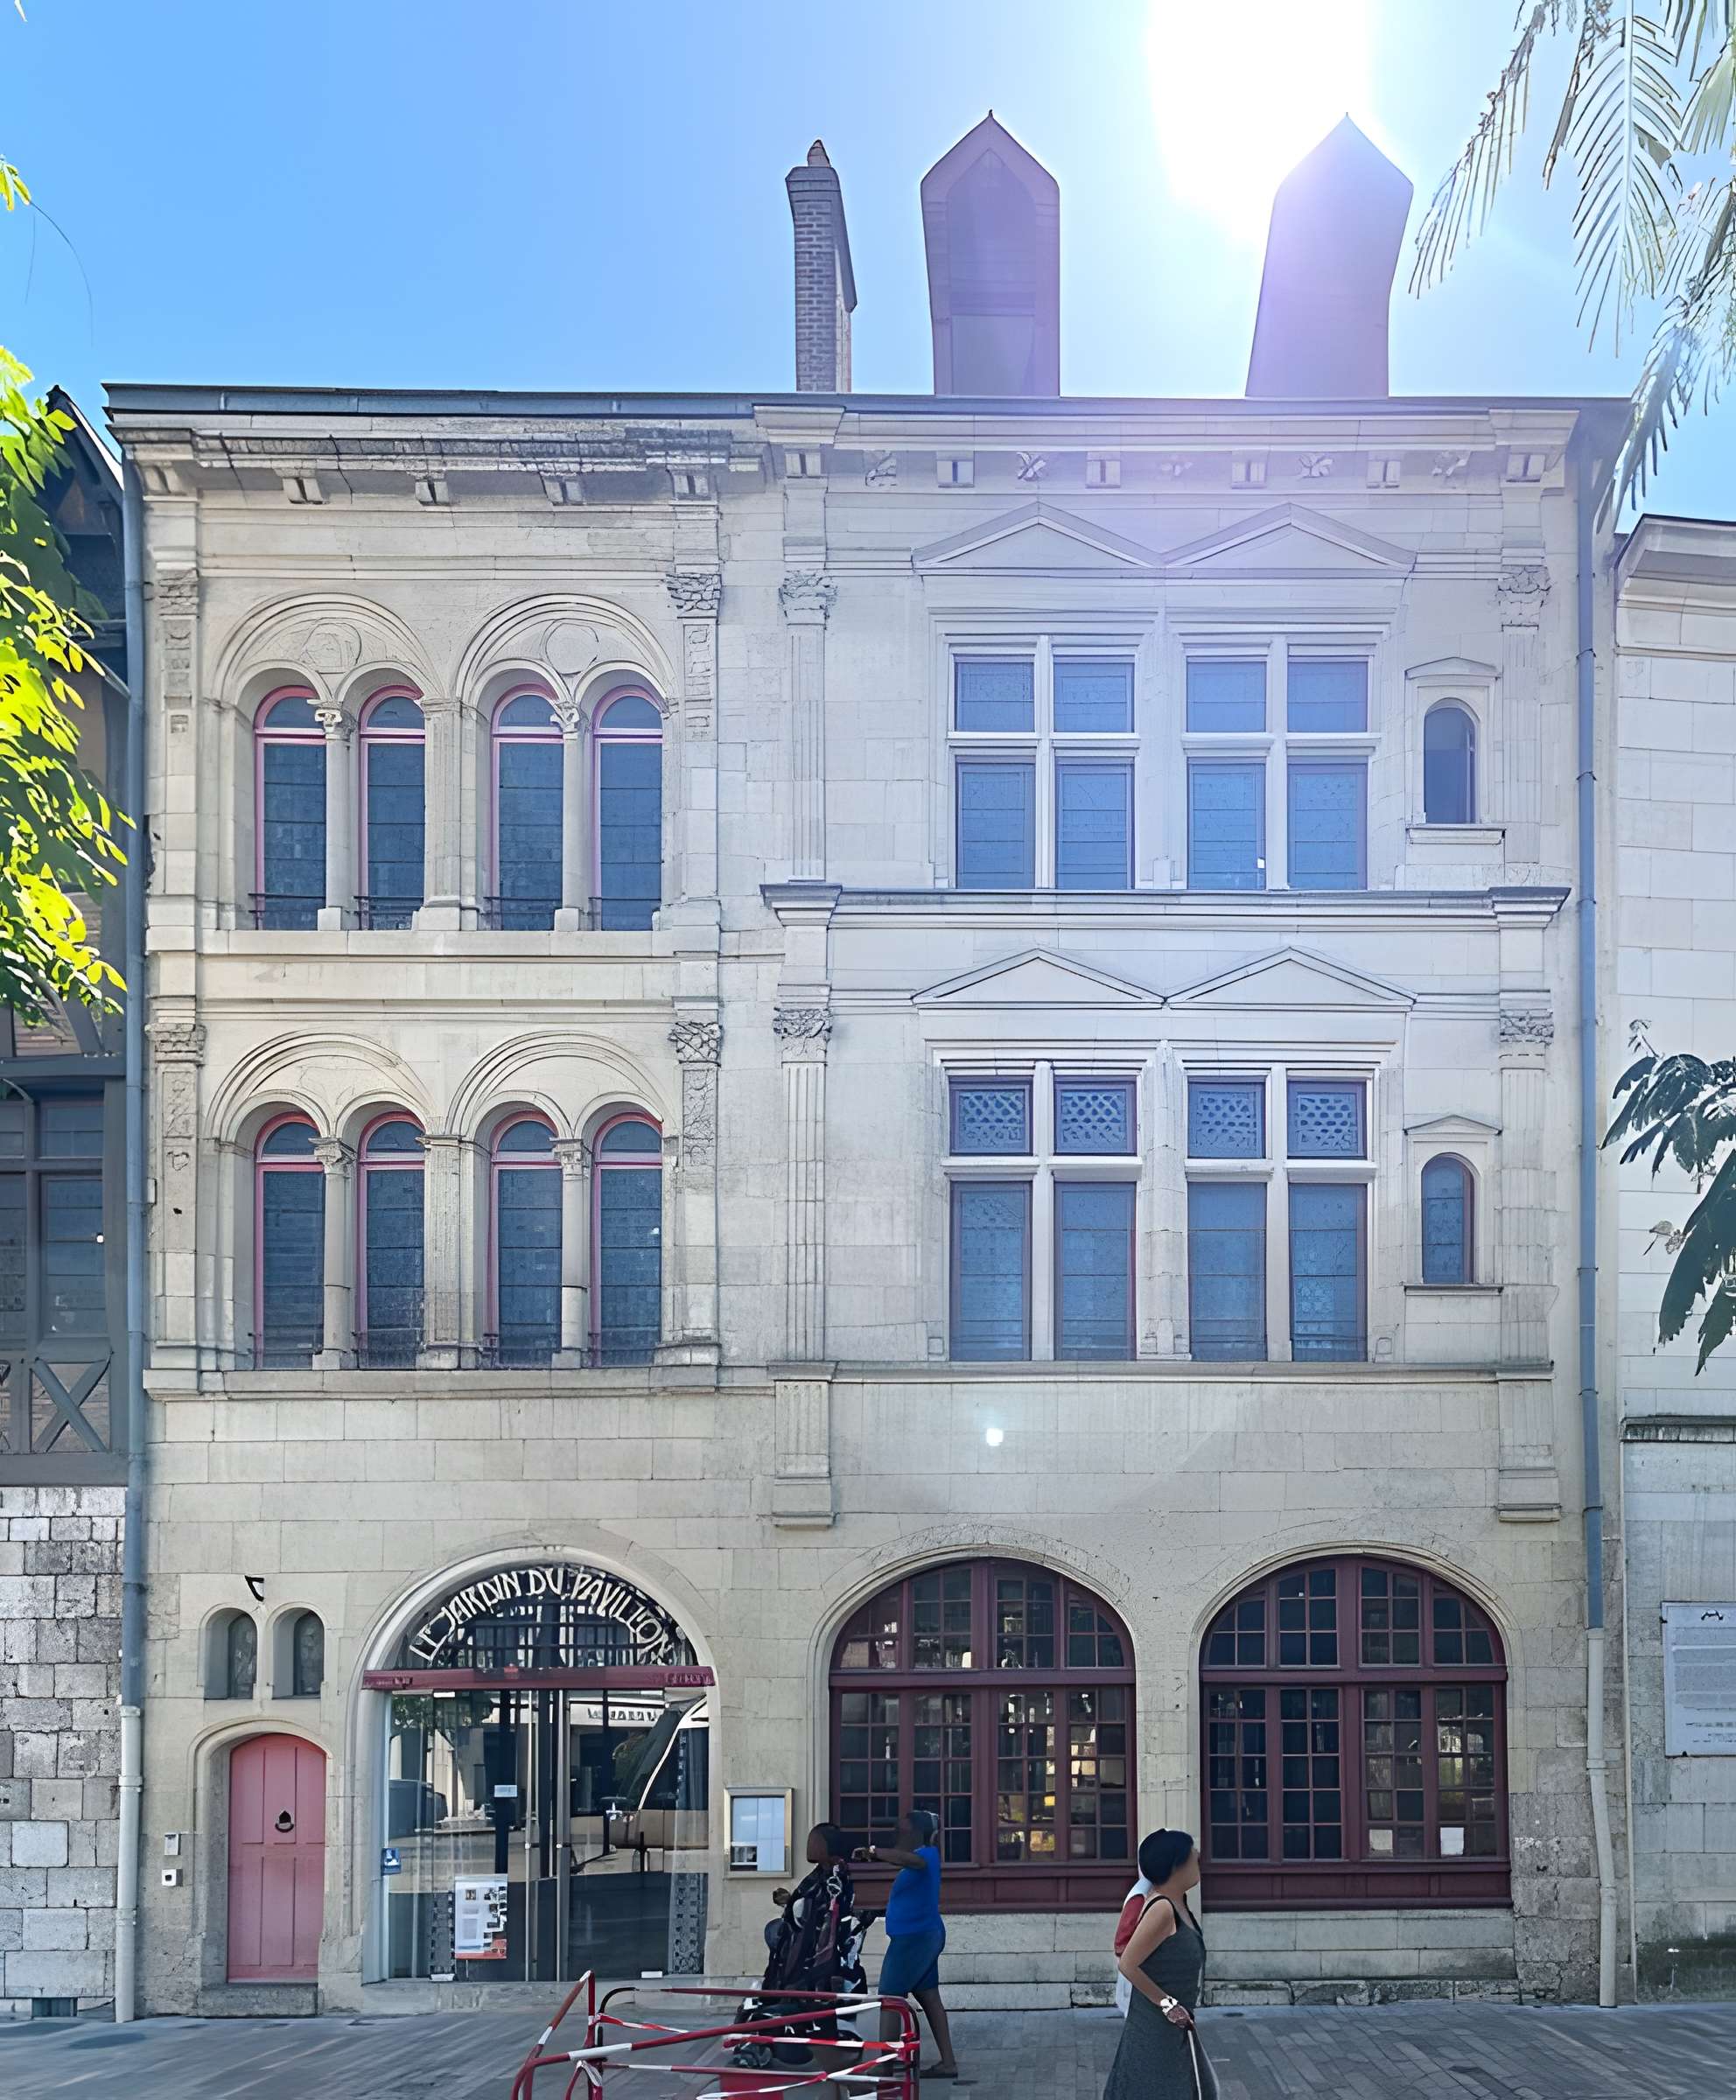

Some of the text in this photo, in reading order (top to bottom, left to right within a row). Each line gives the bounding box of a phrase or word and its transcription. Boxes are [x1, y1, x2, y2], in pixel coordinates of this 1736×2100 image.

[409, 1622, 447, 1662] LE
[438, 1572, 522, 1635] JARDIN
[526, 1567, 565, 1596] DU
